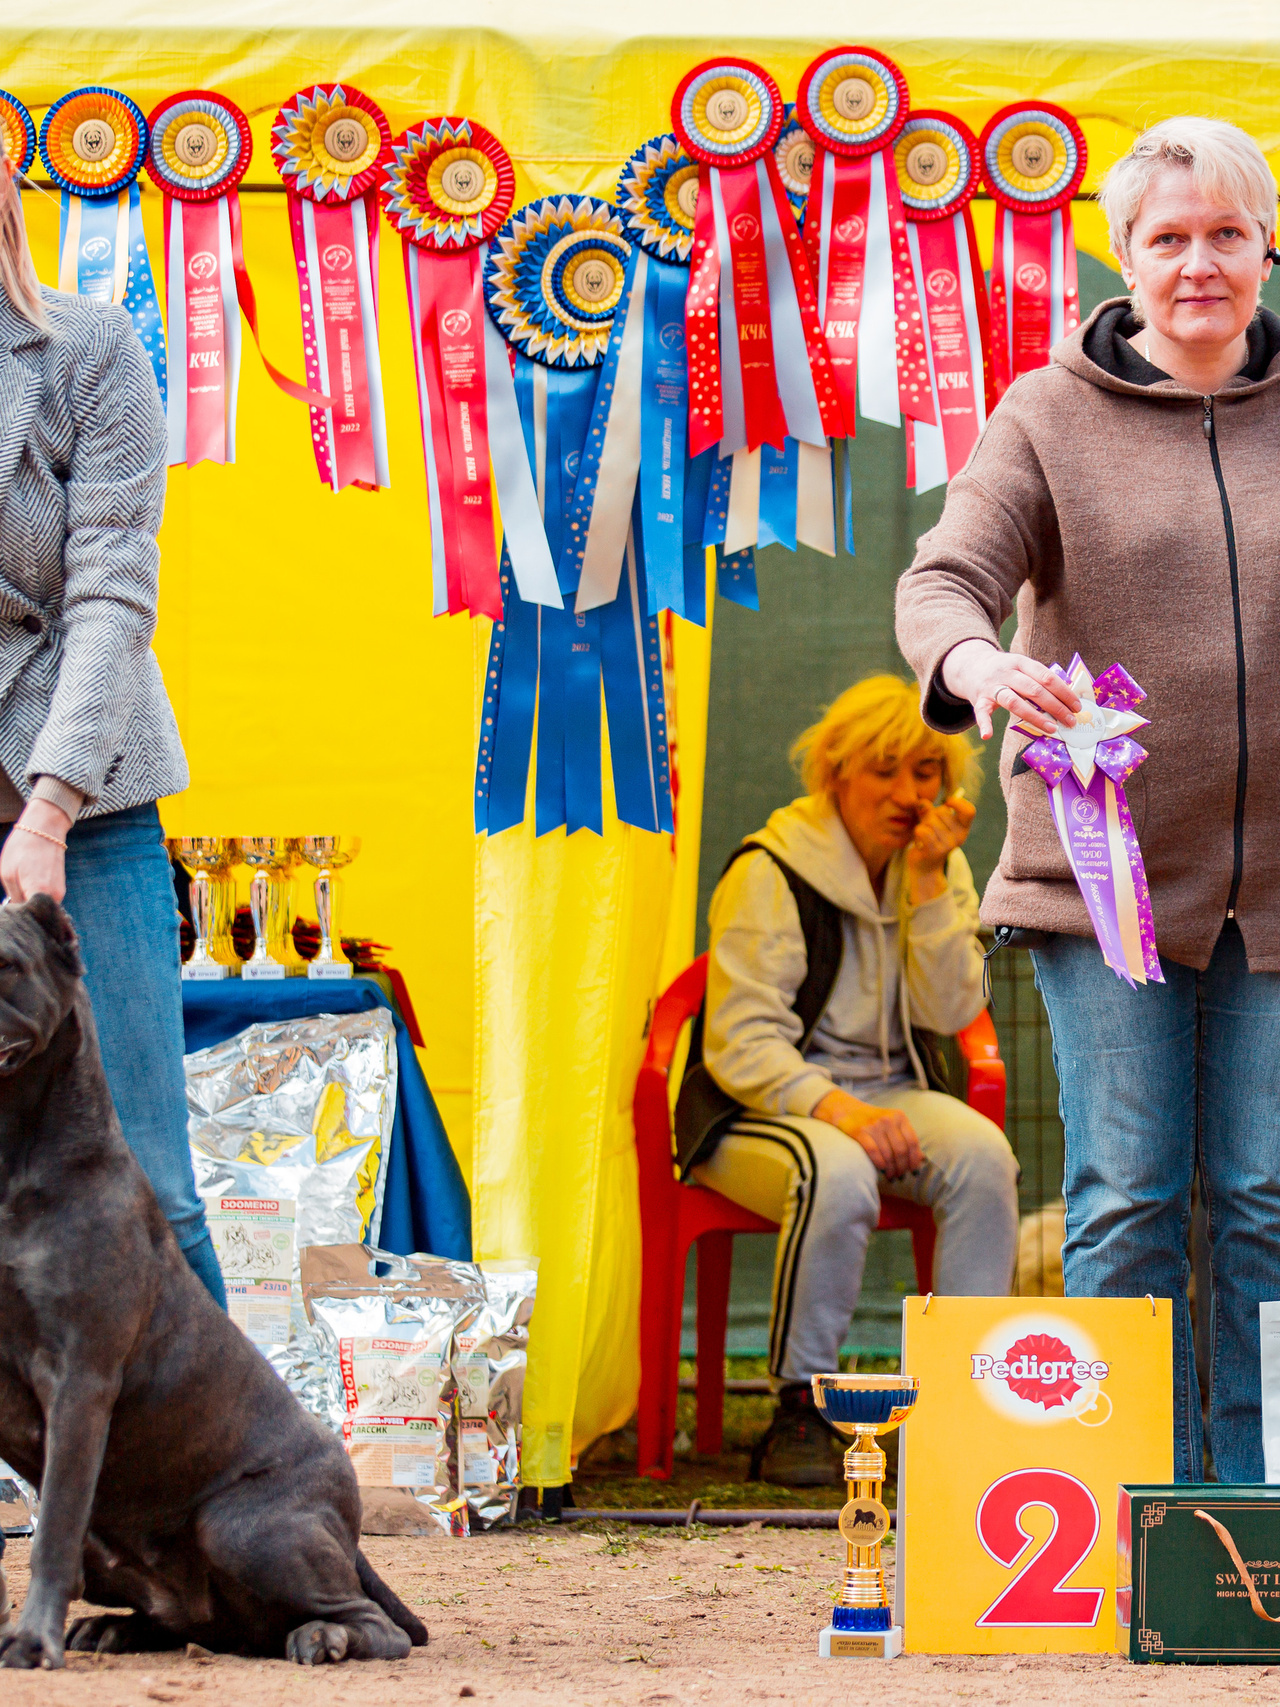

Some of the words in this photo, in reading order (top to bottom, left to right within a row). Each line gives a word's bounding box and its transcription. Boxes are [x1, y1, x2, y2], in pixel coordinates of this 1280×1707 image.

[740, 323, 768, 341] КЧК
[825, 320, 858, 338] КЧК
[189, 350, 221, 368] КЧК
[937, 371, 970, 390] КЧК
[340, 424, 361, 434] 2022
[463, 496, 483, 505] 2022
[1081, 850, 1103, 859] ЧУДО
[222, 1200, 278, 1210] ЗООМЕНЮ
[263, 1283, 288, 1292] 23/10
[971, 1354, 1109, 1384] Pedigree
[351, 1426, 388, 1434] КЛАССИК
[409, 1423, 433, 1431] 23/12
[975, 1467, 1105, 1627] 2
[1215, 1573, 1271, 1586] SWET
[1216, 1590, 1235, 1598] HIGH
[1236, 1590, 1269, 1598] QUITY
